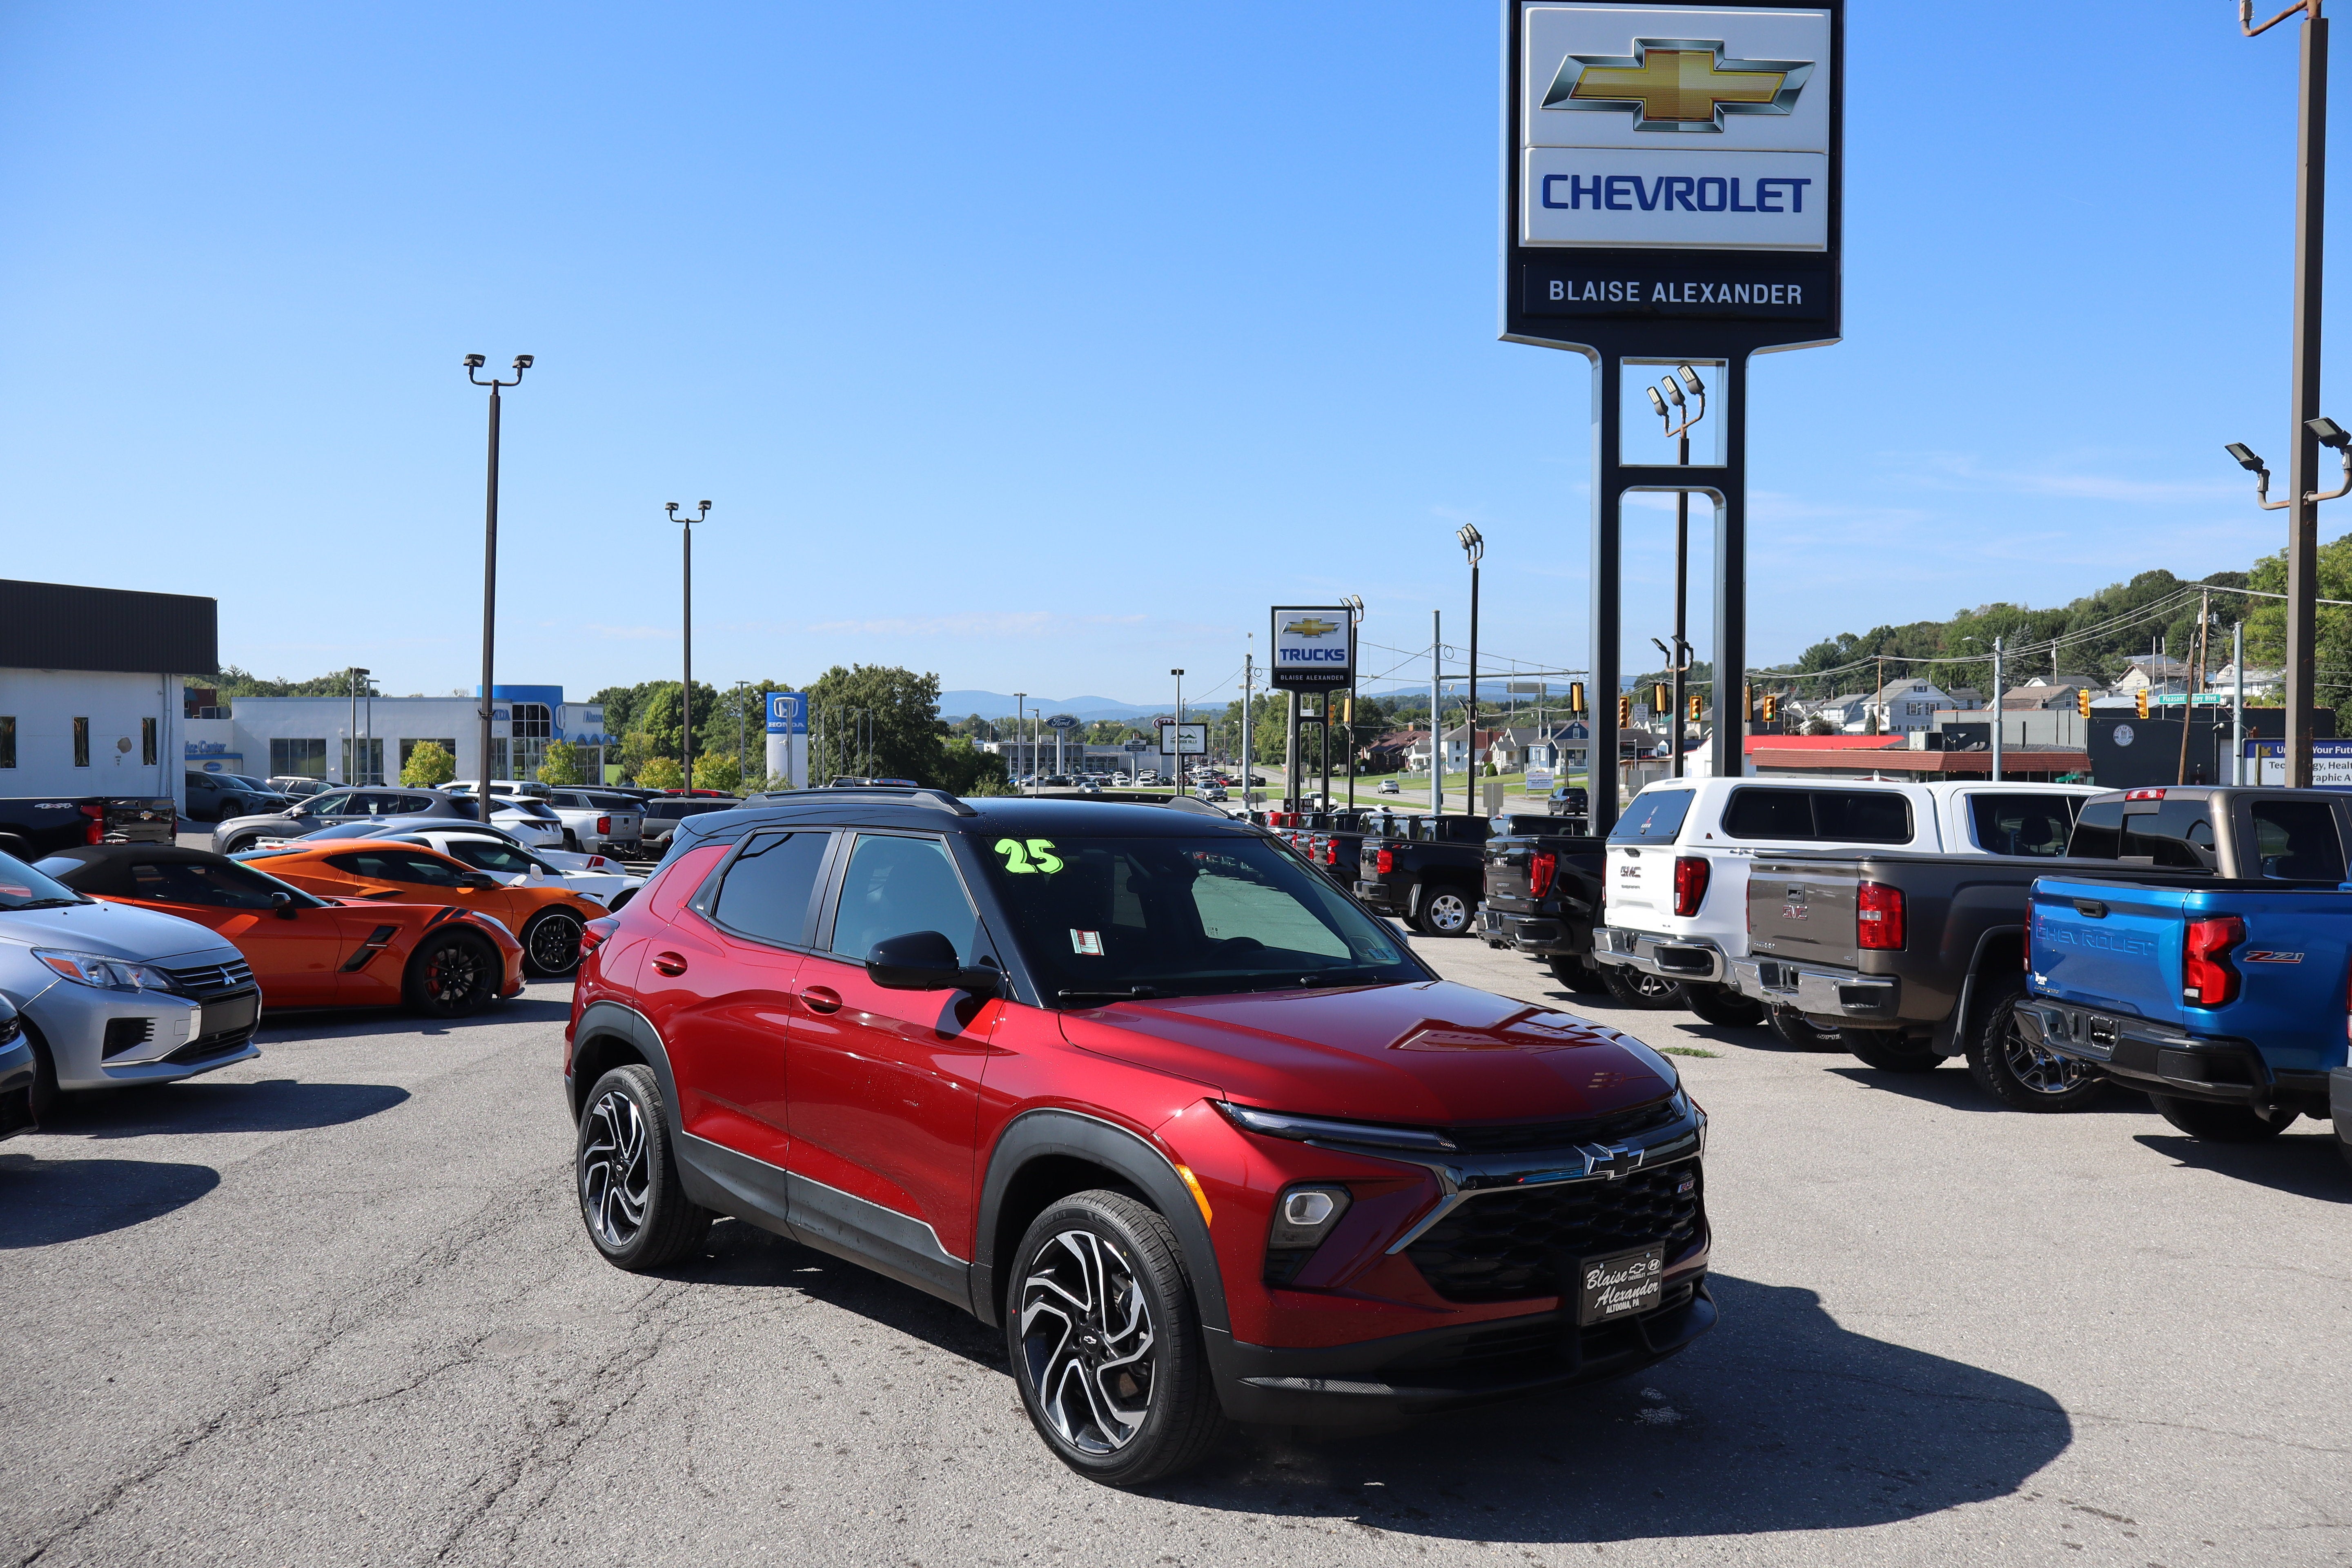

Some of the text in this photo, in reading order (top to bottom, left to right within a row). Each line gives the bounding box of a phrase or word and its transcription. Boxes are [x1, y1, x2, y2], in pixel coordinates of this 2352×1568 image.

[1542, 174, 1811, 212] CHEVROLET
[1549, 281, 1802, 305] BLAISE ALEXANDER
[1280, 648, 1345, 661] TRUCKS
[1051, 718, 1071, 726] Ford
[2313, 746, 2333, 754] Your
[995, 838, 1064, 874] 25
[1620, 866, 1642, 878] GMC
[1782, 904, 1808, 920] GMC
[2036, 925, 2155, 956] CHEVROLET
[2243, 951, 2304, 964] Z71
[1677, 1179, 1694, 1193] RS
[1028, 1211, 1067, 1242] ELITE EDGE A/S
[1587, 1269, 1628, 1290] Blaise
[1628, 1272, 1646, 1281] CHEVROLET
[1594, 1278, 1659, 1309] Alexander
[1606, 1298, 1639, 1314] ALTOONA, PA
